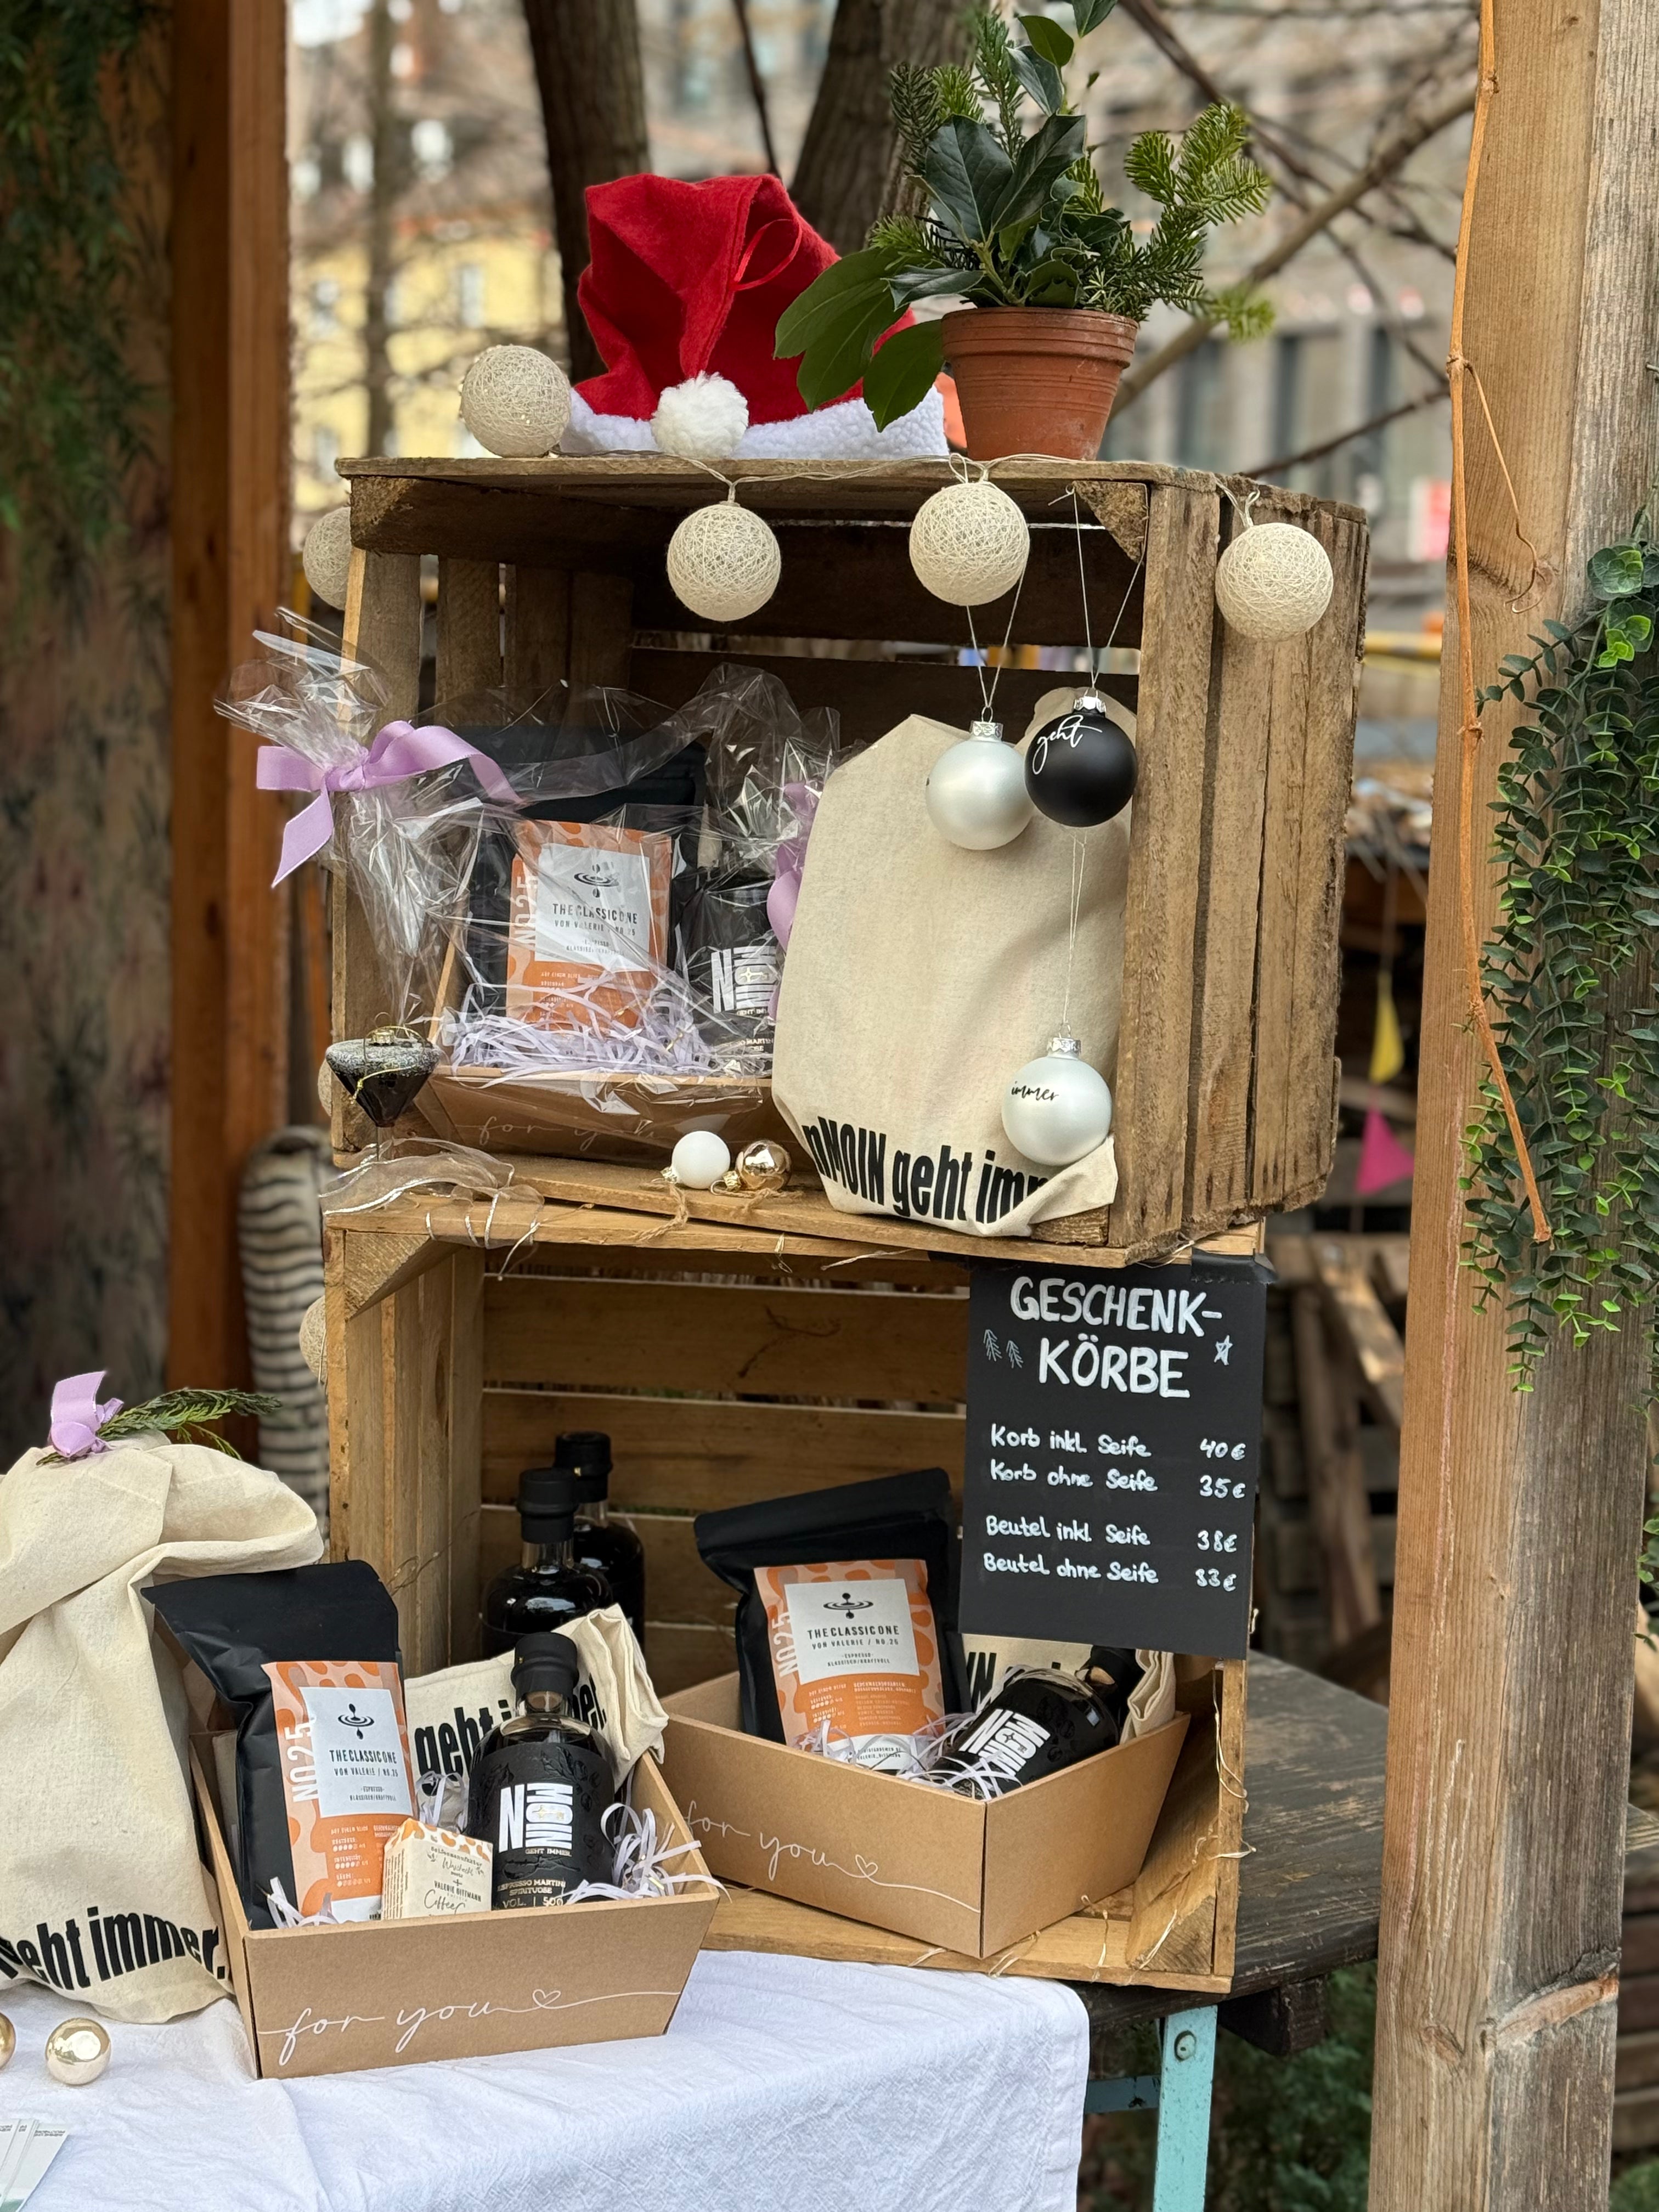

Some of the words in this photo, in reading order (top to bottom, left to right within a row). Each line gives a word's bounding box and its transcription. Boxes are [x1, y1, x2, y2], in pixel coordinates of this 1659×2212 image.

[1032, 715, 1103, 774] geht
[1011, 1081, 1059, 1101] immer
[478, 1116, 561, 1146] for
[893, 1146, 972, 1221] geht
[1011, 1276, 1222, 1337] GESCHENK-
[1039, 1333, 1190, 1398] KÖRBE
[991, 1423, 1041, 1447] Korb
[1098, 1434, 1152, 1457] Seife
[990, 1459, 1037, 1481] Korb
[1047, 1465, 1093, 1487] ohne
[1106, 1468, 1158, 1491] Seife
[986, 1515, 1051, 1537] Beutel
[1105, 1524, 1151, 1545] Seife
[984, 1553, 1050, 1575] Beutel
[1057, 1558, 1102, 1580] ohne
[1107, 1561, 1159, 1584] Seife
[812, 1641, 827, 1650] VON
[831, 1639, 864, 1647] VALERIE
[414, 1706, 494, 1797] geht
[334, 1767, 348, 1776] VON
[351, 1767, 376, 1775] VALERIE
[760, 1831, 832, 1881] you
[278, 2007, 385, 2066] for
[396, 2000, 494, 2053] you
